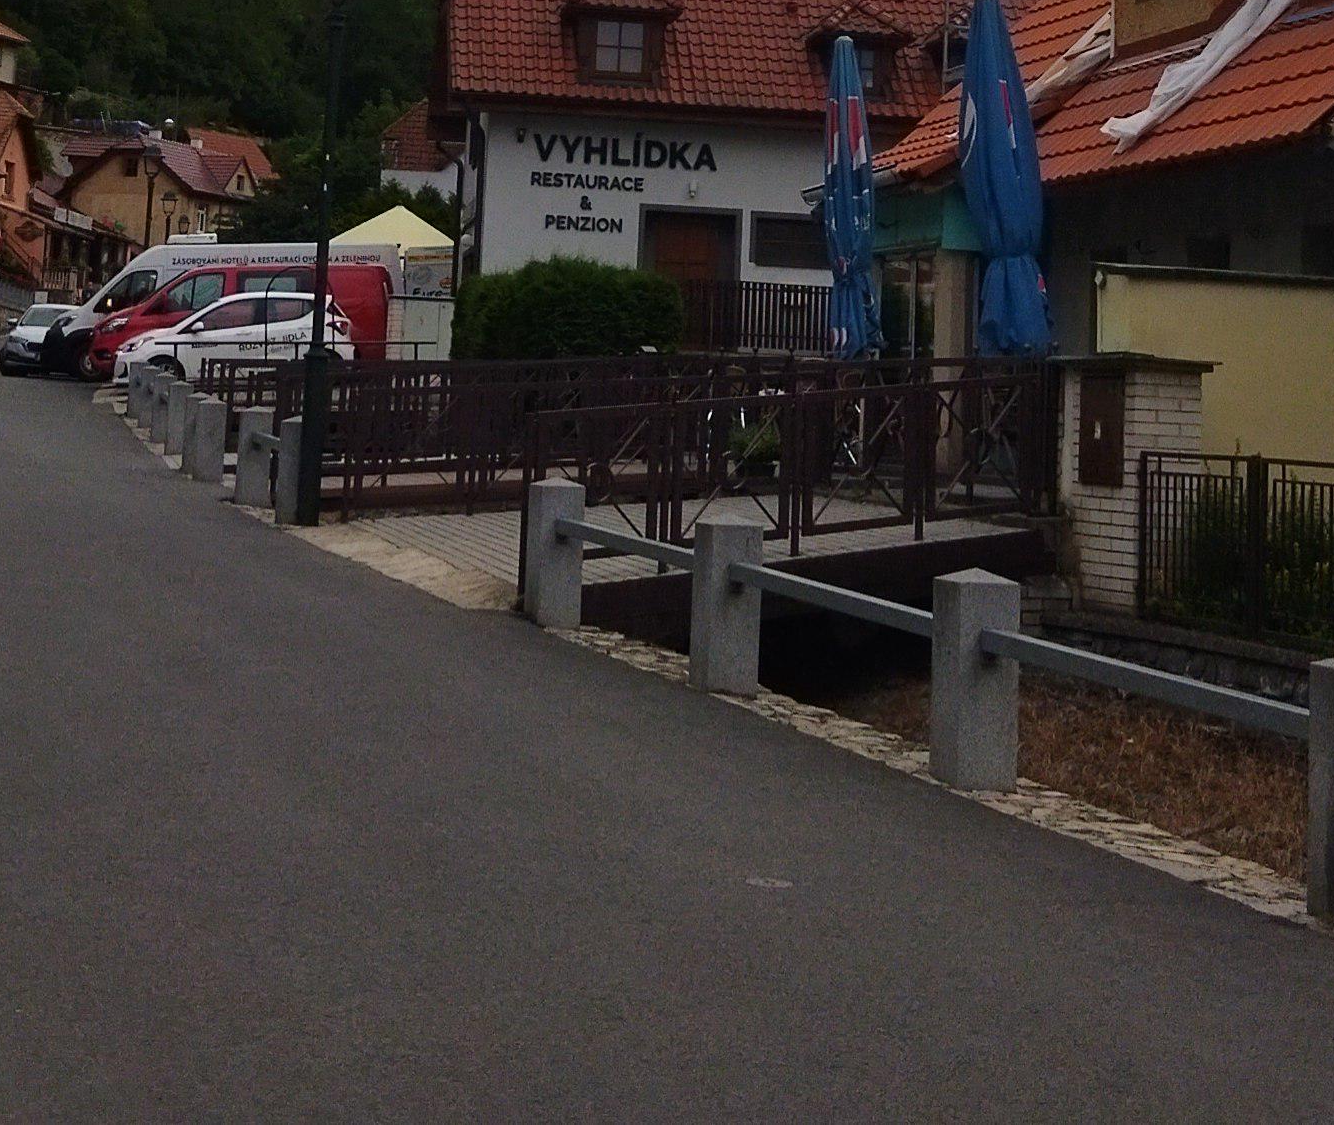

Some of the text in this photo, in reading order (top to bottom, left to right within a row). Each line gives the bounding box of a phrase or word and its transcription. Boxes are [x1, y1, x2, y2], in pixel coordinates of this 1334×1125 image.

[534, 132, 717, 172] VYHLÍDKA
[530, 172, 645, 192] RESTAURACE
[580, 196, 593, 211] &
[544, 215, 623, 234] PENZION
